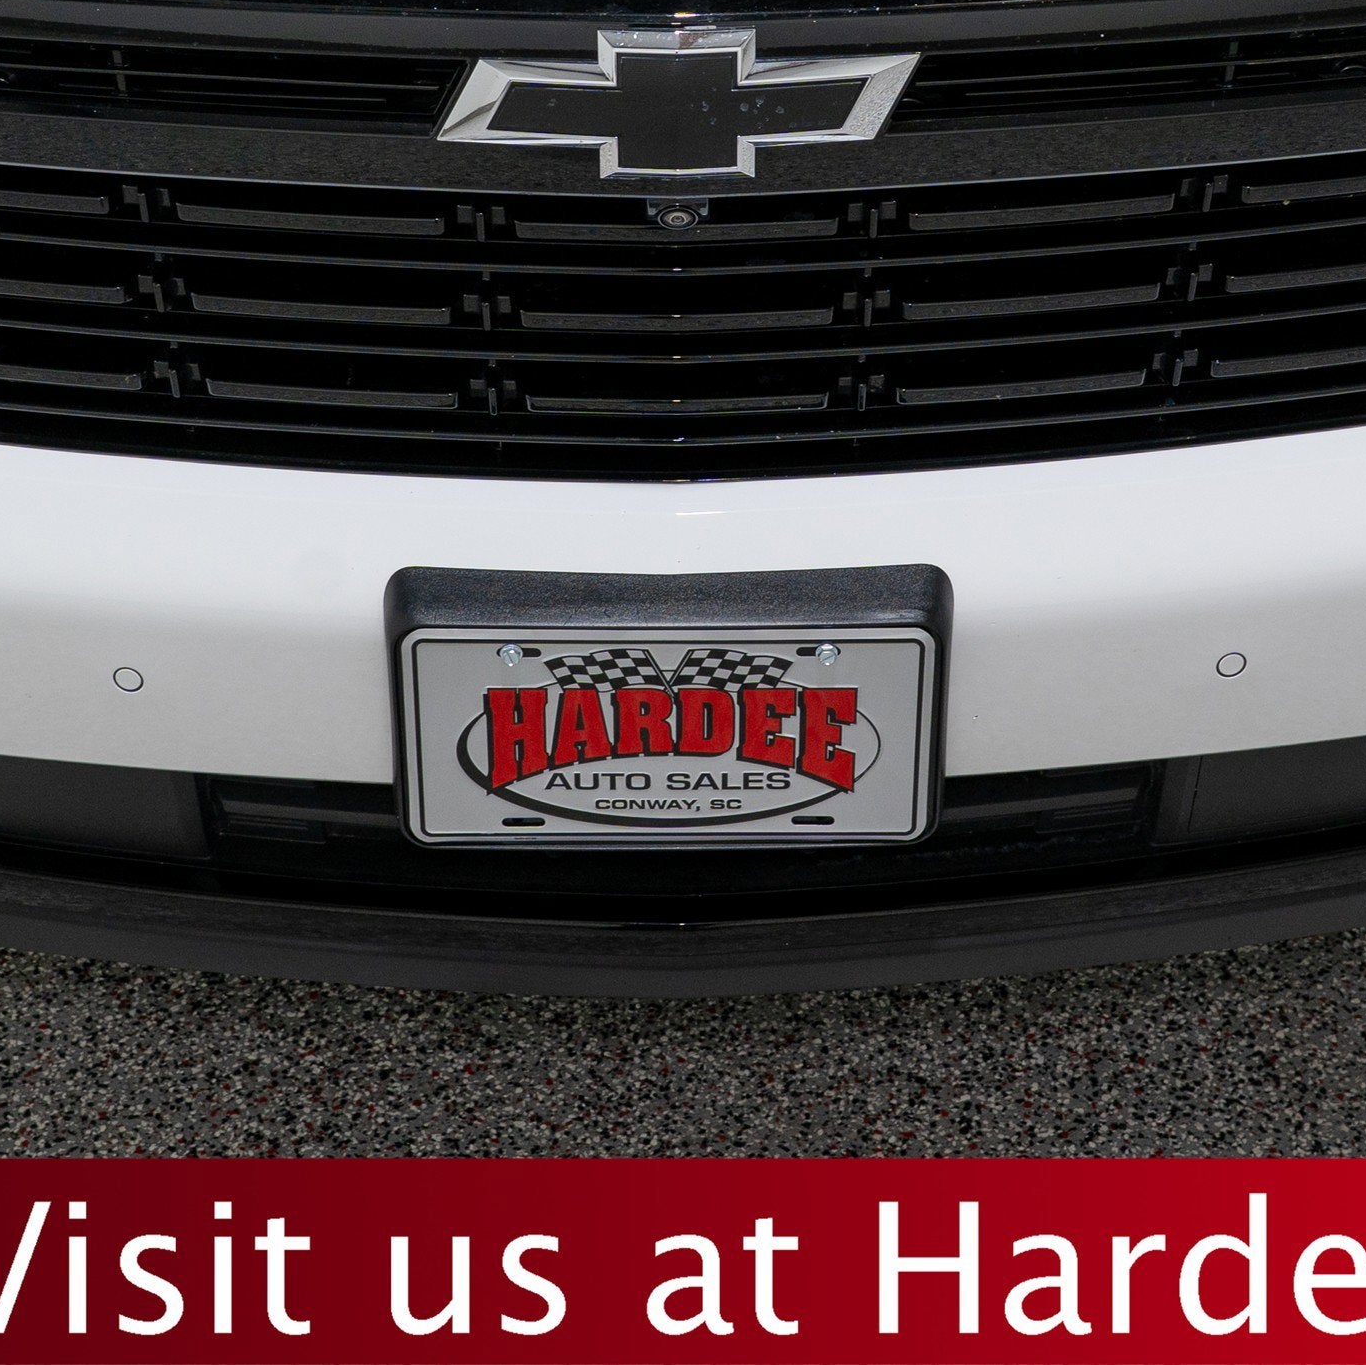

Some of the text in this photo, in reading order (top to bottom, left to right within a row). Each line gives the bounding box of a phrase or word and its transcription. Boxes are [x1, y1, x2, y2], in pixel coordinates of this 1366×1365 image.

[484, 686, 858, 794] HARDEE
[544, 771, 792, 791] AUTO SALES
[594, 798, 743, 812] CONWAY, SC
